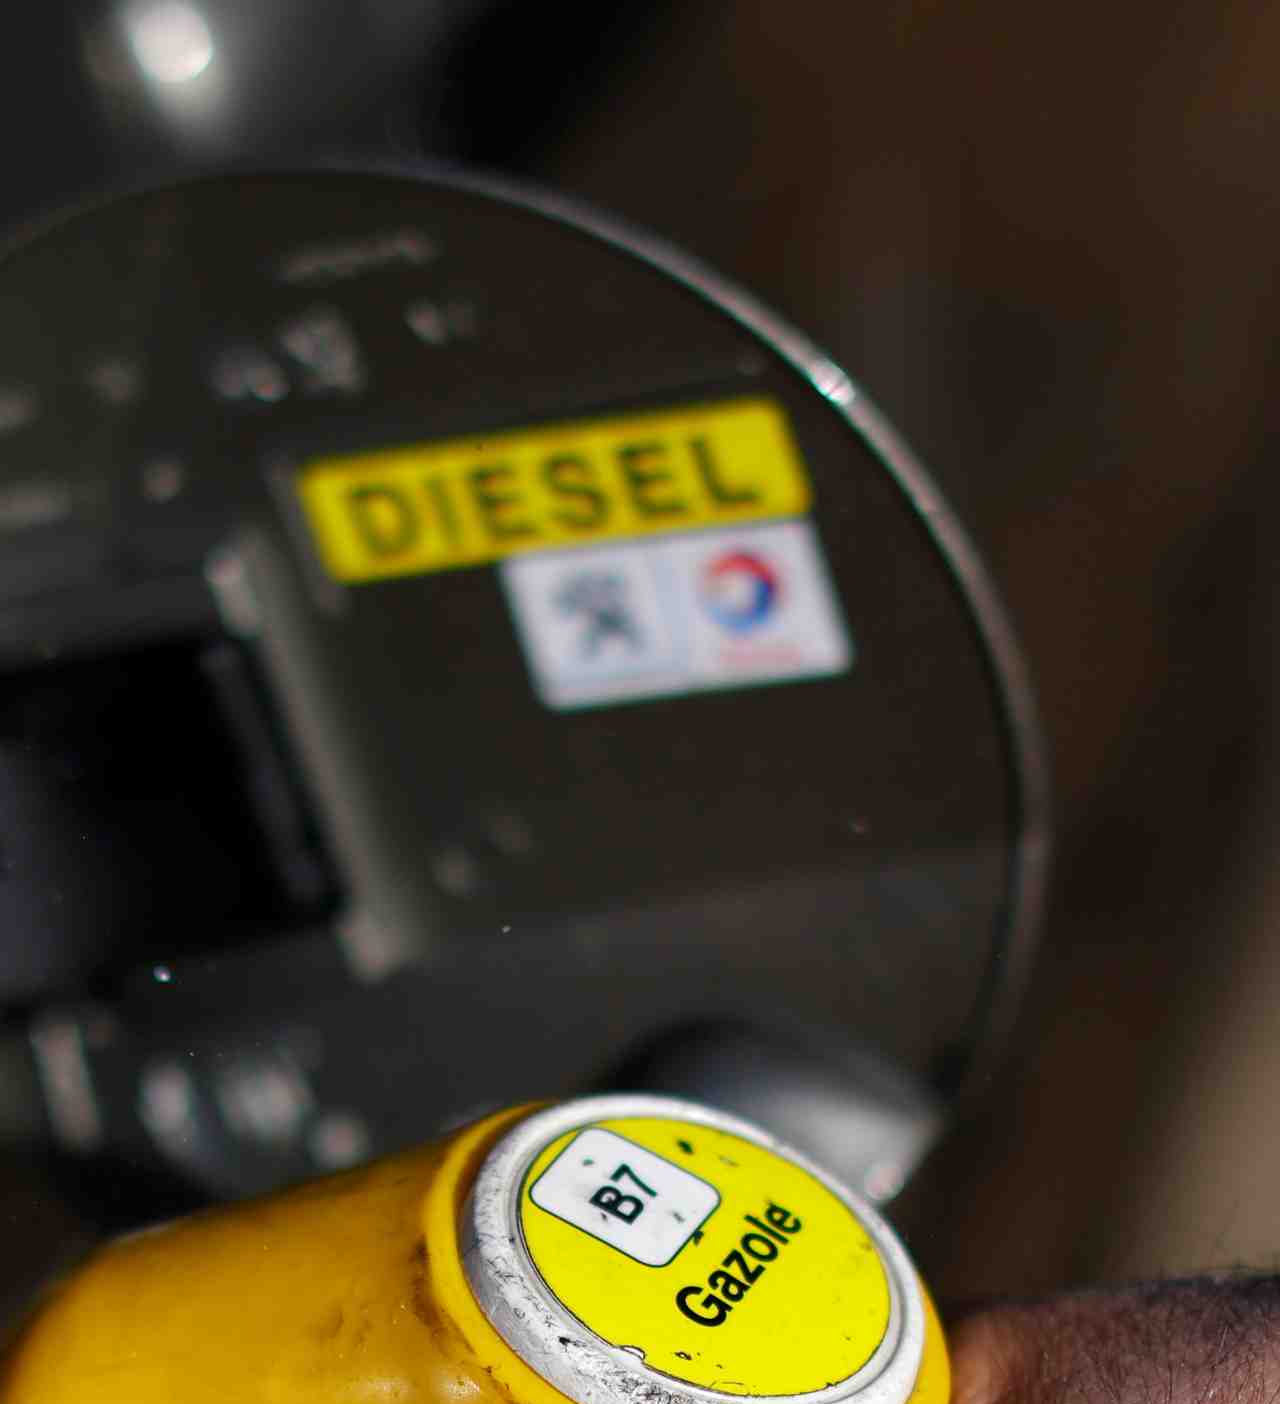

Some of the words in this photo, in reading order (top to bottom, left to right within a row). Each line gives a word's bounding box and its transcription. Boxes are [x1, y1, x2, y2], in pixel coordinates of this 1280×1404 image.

[347, 434, 762, 561] DIESEL
[588, 1163, 658, 1225] B7
[675, 1200, 803, 1328] Gazole
